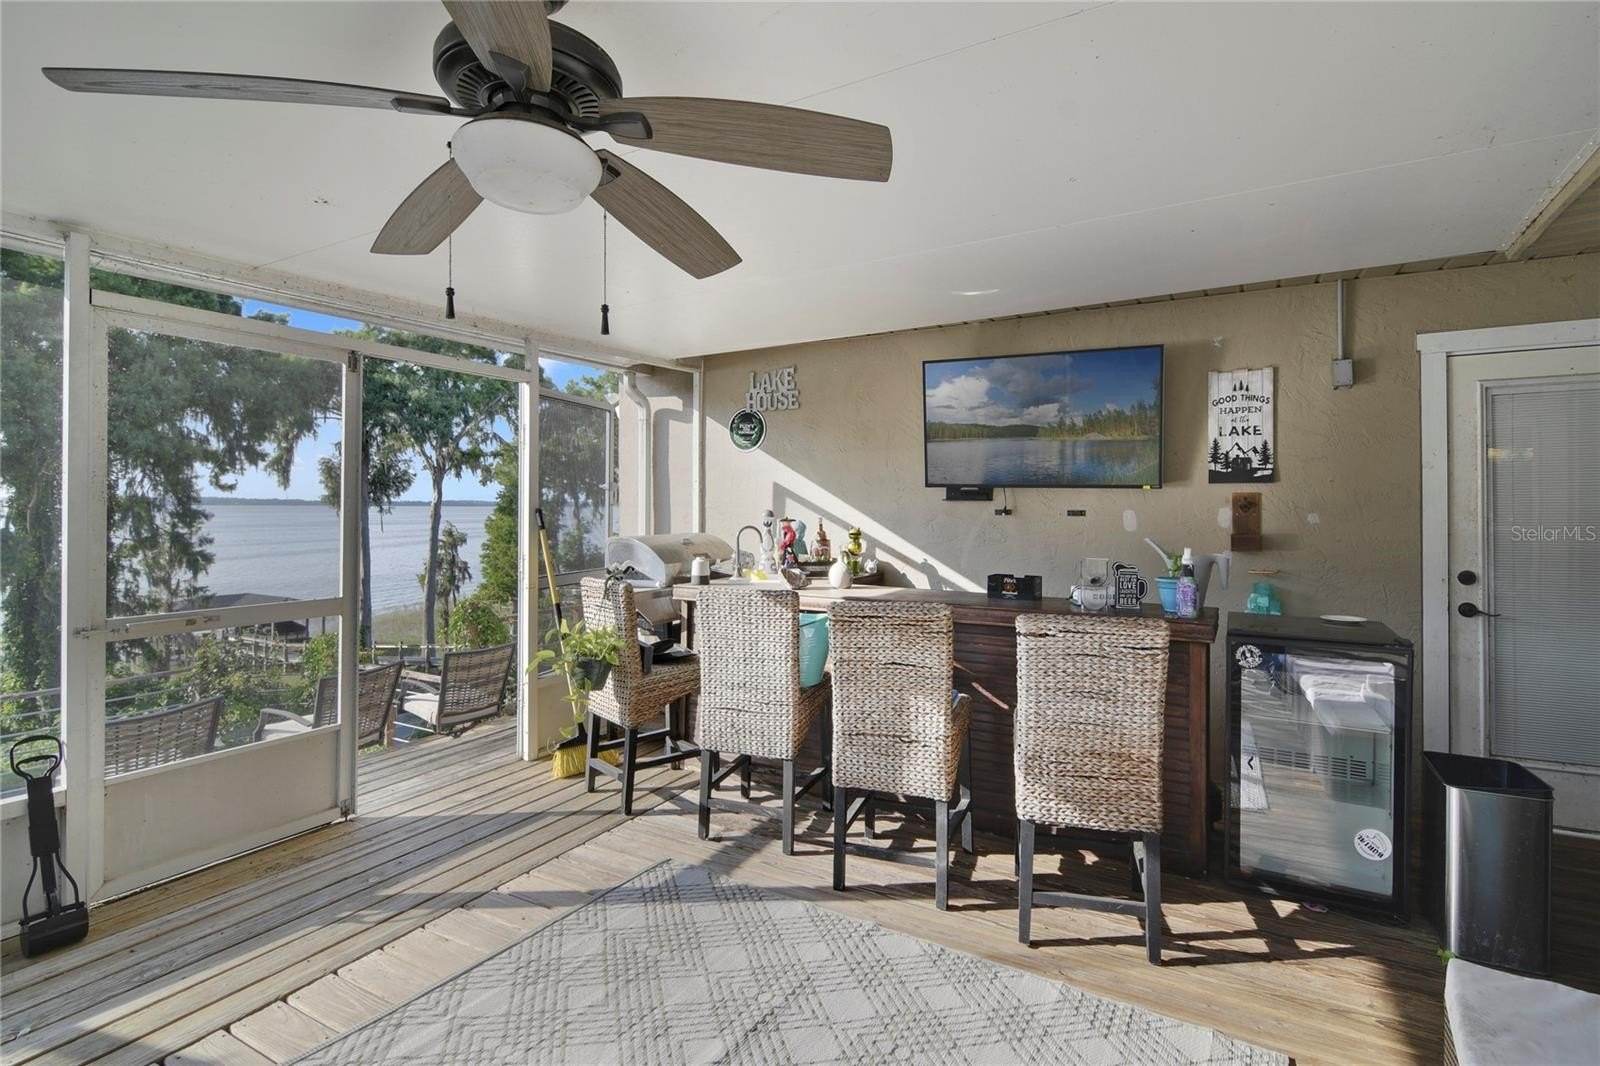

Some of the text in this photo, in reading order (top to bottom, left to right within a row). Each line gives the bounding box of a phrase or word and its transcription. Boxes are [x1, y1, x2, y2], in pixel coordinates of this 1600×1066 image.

[749, 367, 796, 392] LAKE
[745, 390, 800, 412] HOUSE
[1212, 394, 1271, 407] GOOD THINGS
[1219, 406, 1263, 415] HAPPEN
[1219, 425, 1262, 437] LAKE
[1119, 581, 1137, 589] LOVE
[1119, 597, 1137, 605] BEER
